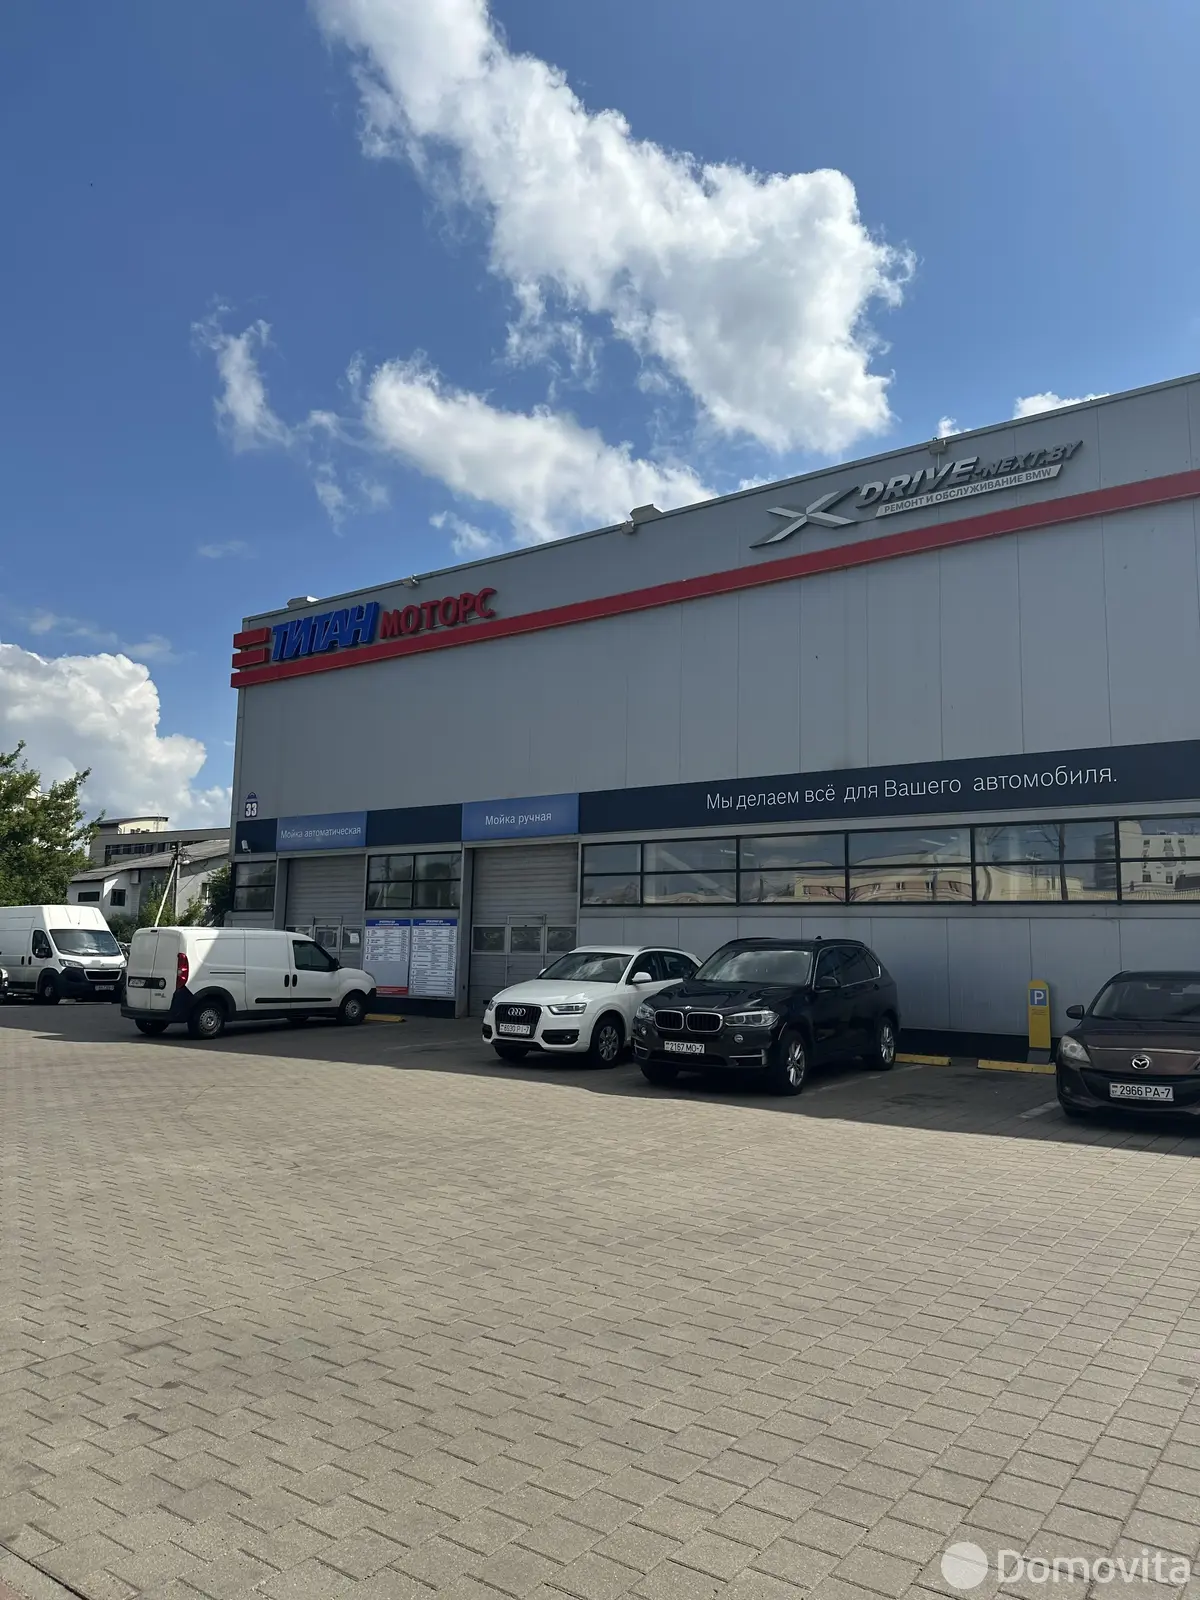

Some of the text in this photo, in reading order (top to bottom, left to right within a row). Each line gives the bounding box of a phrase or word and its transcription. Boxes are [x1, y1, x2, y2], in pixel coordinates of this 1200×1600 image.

[884, 468, 1052, 513] РЕМОНТ И ОБСЛУЖИВАНИЕ BMW
[271, 588, 497, 661] ТИТАН МОТОРС
[706, 765, 1118, 811] Мы делаем всё для Вашего автомобиля.
[245, 803, 257, 816] 33
[485, 812, 552, 826] Мойка ручная
[280, 826, 362, 839] Мойка автоматическая
[1034, 990, 1044, 1005] P
[1119, 1085, 1171, 1098] 2966 PA-7
